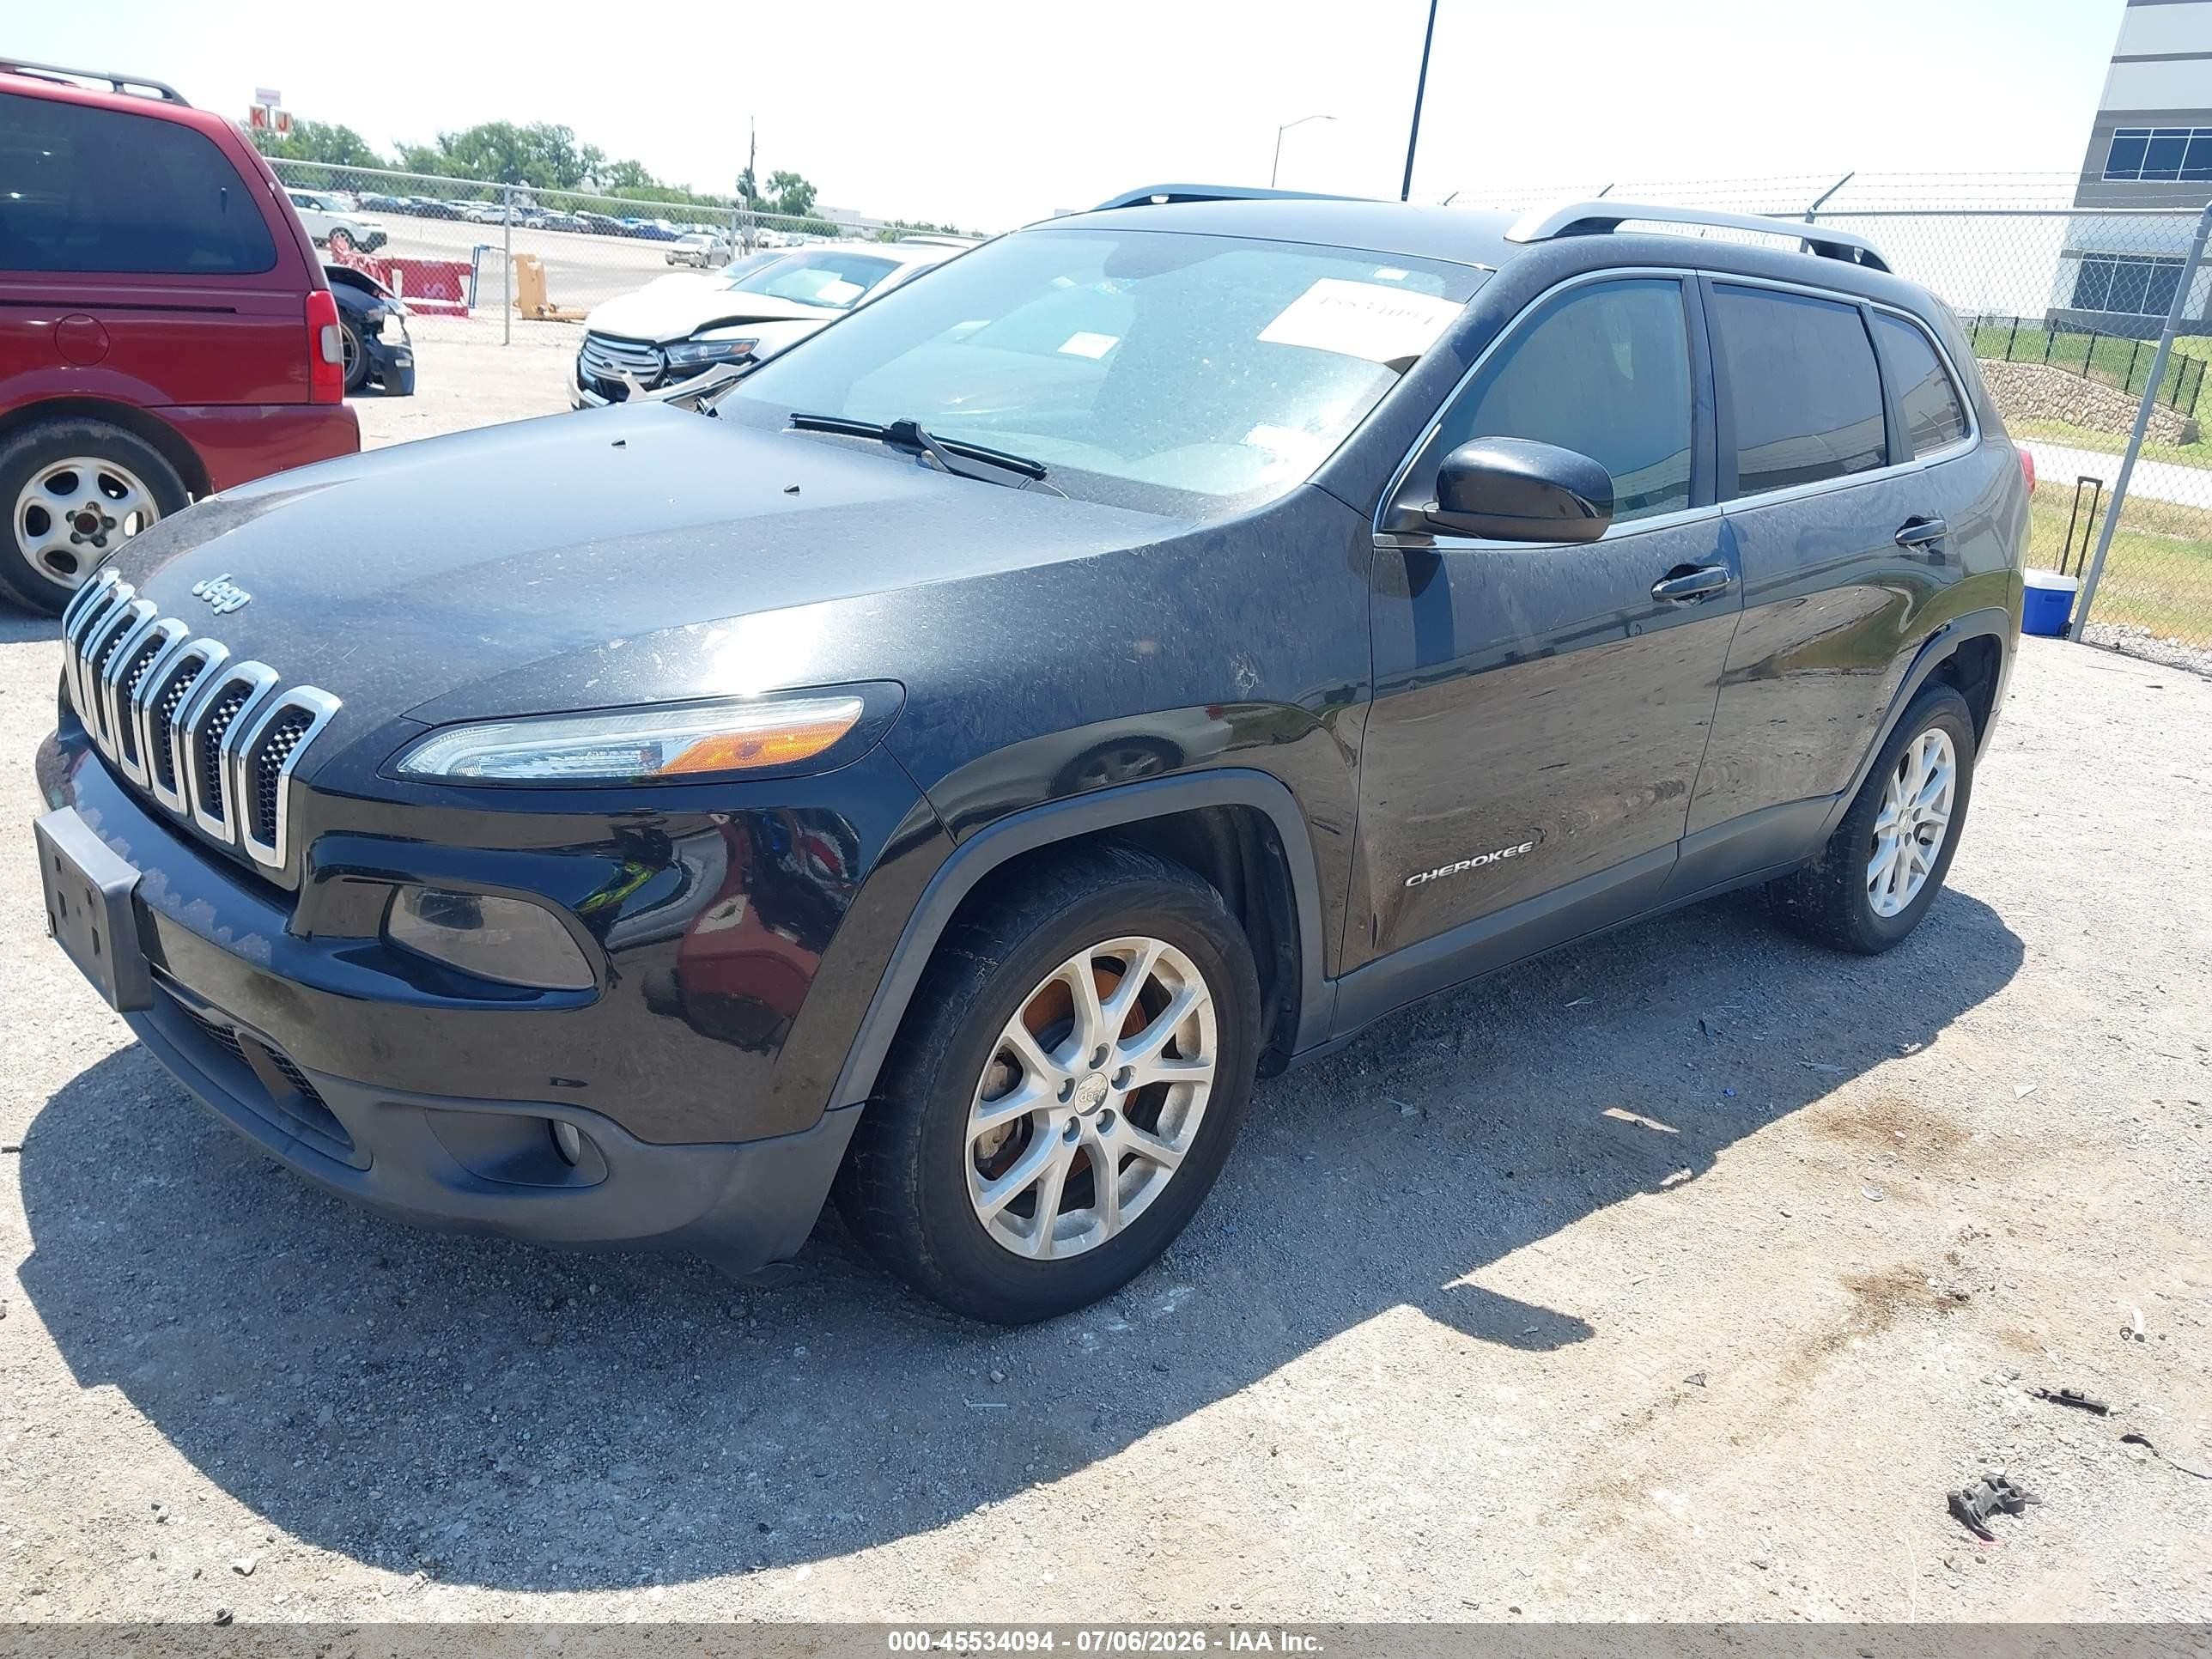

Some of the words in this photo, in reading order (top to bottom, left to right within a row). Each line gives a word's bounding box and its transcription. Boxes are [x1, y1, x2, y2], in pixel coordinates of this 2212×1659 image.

[252, 108, 264, 127] K
[278, 113, 289, 131] J
[191, 573, 252, 615] Jeep
[1405, 841, 1534, 887] CHEROKEE
